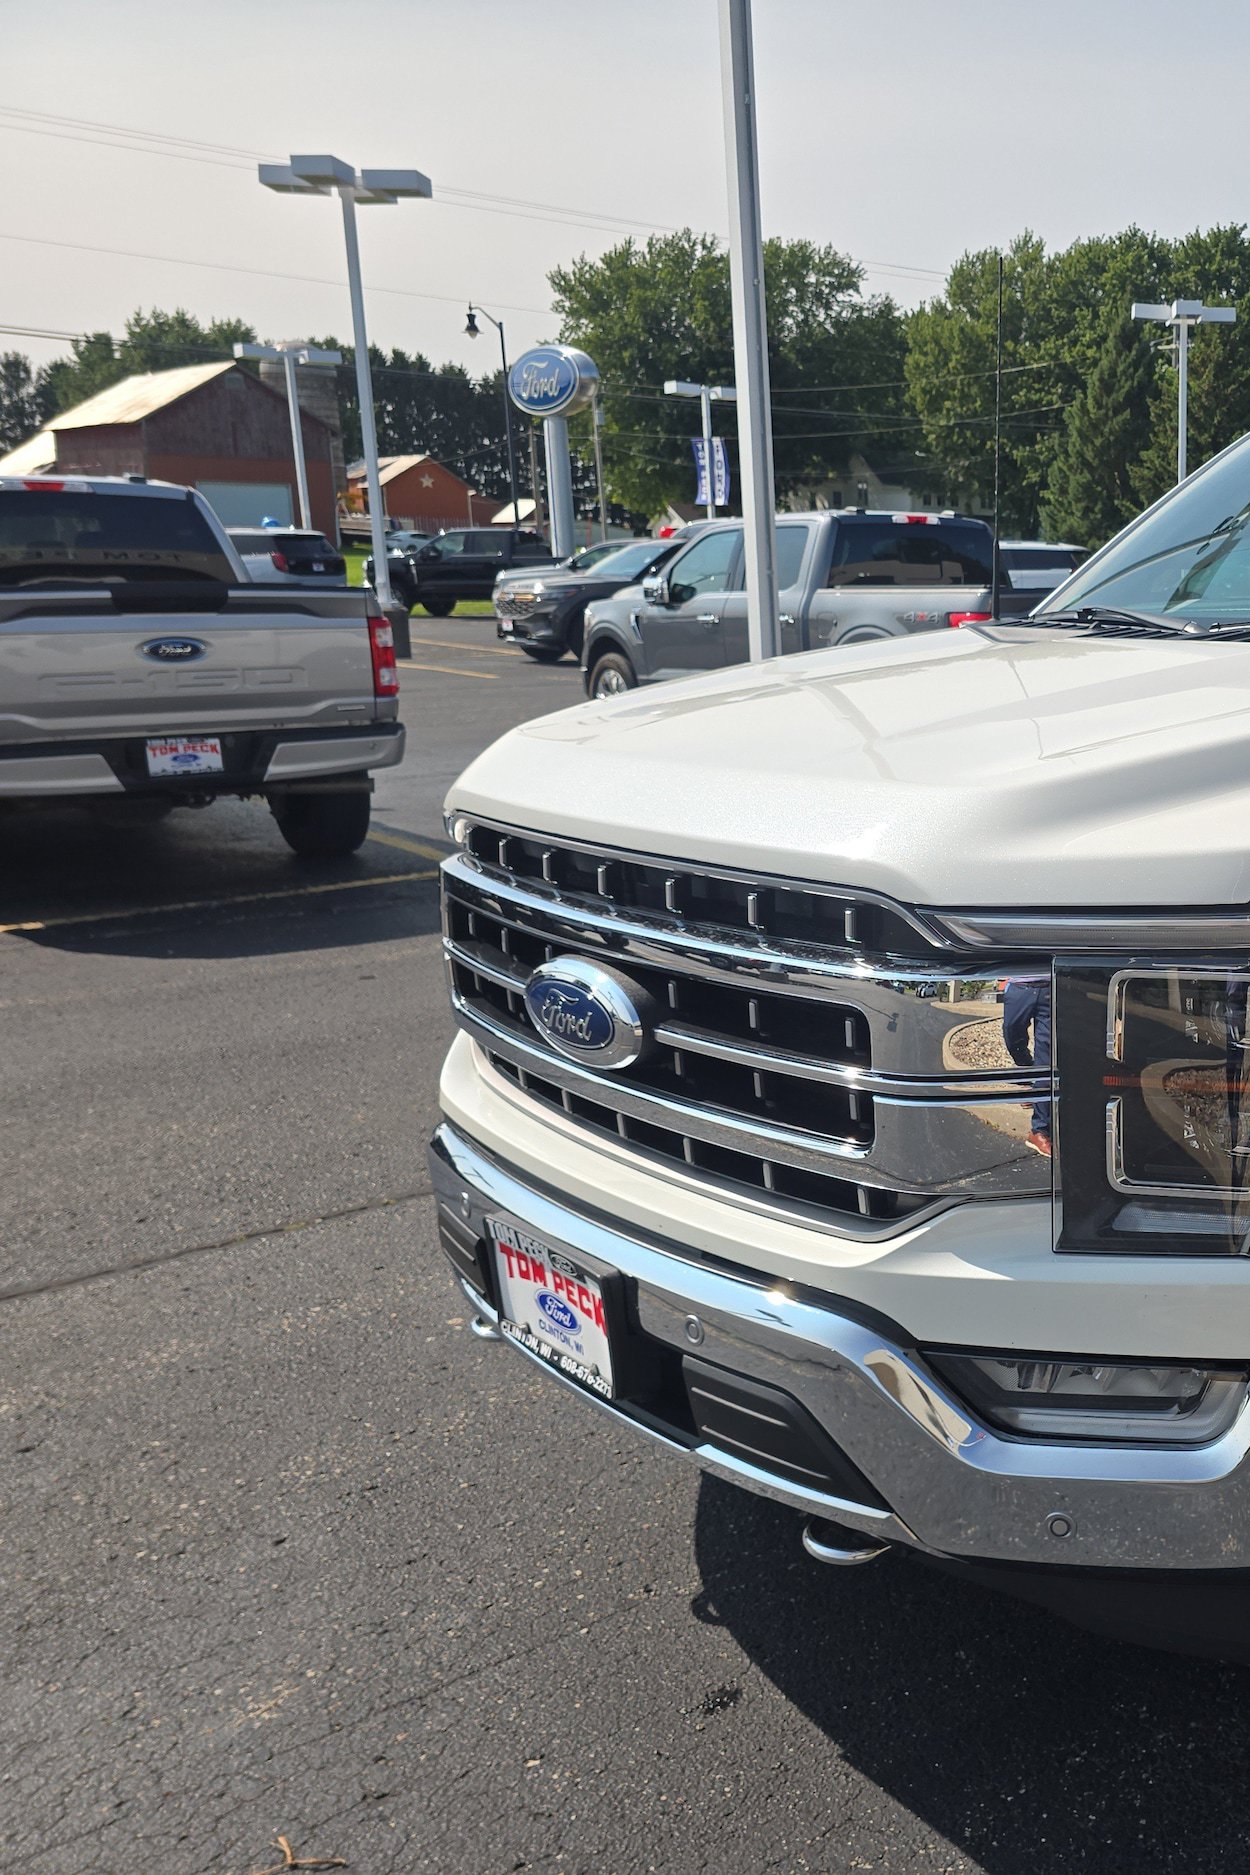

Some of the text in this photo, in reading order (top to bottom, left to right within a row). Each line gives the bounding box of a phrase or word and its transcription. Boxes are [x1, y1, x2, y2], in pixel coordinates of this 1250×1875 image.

[521, 361, 561, 400] Ford
[149, 742, 219, 758] TOM PECK
[541, 988, 593, 1041] Ford
[499, 1241, 607, 1337] TOM PECK
[545, 1296, 572, 1328] Ford
[500, 1320, 540, 1354] CLINTON,
[539, 1342, 553, 1360] WI
